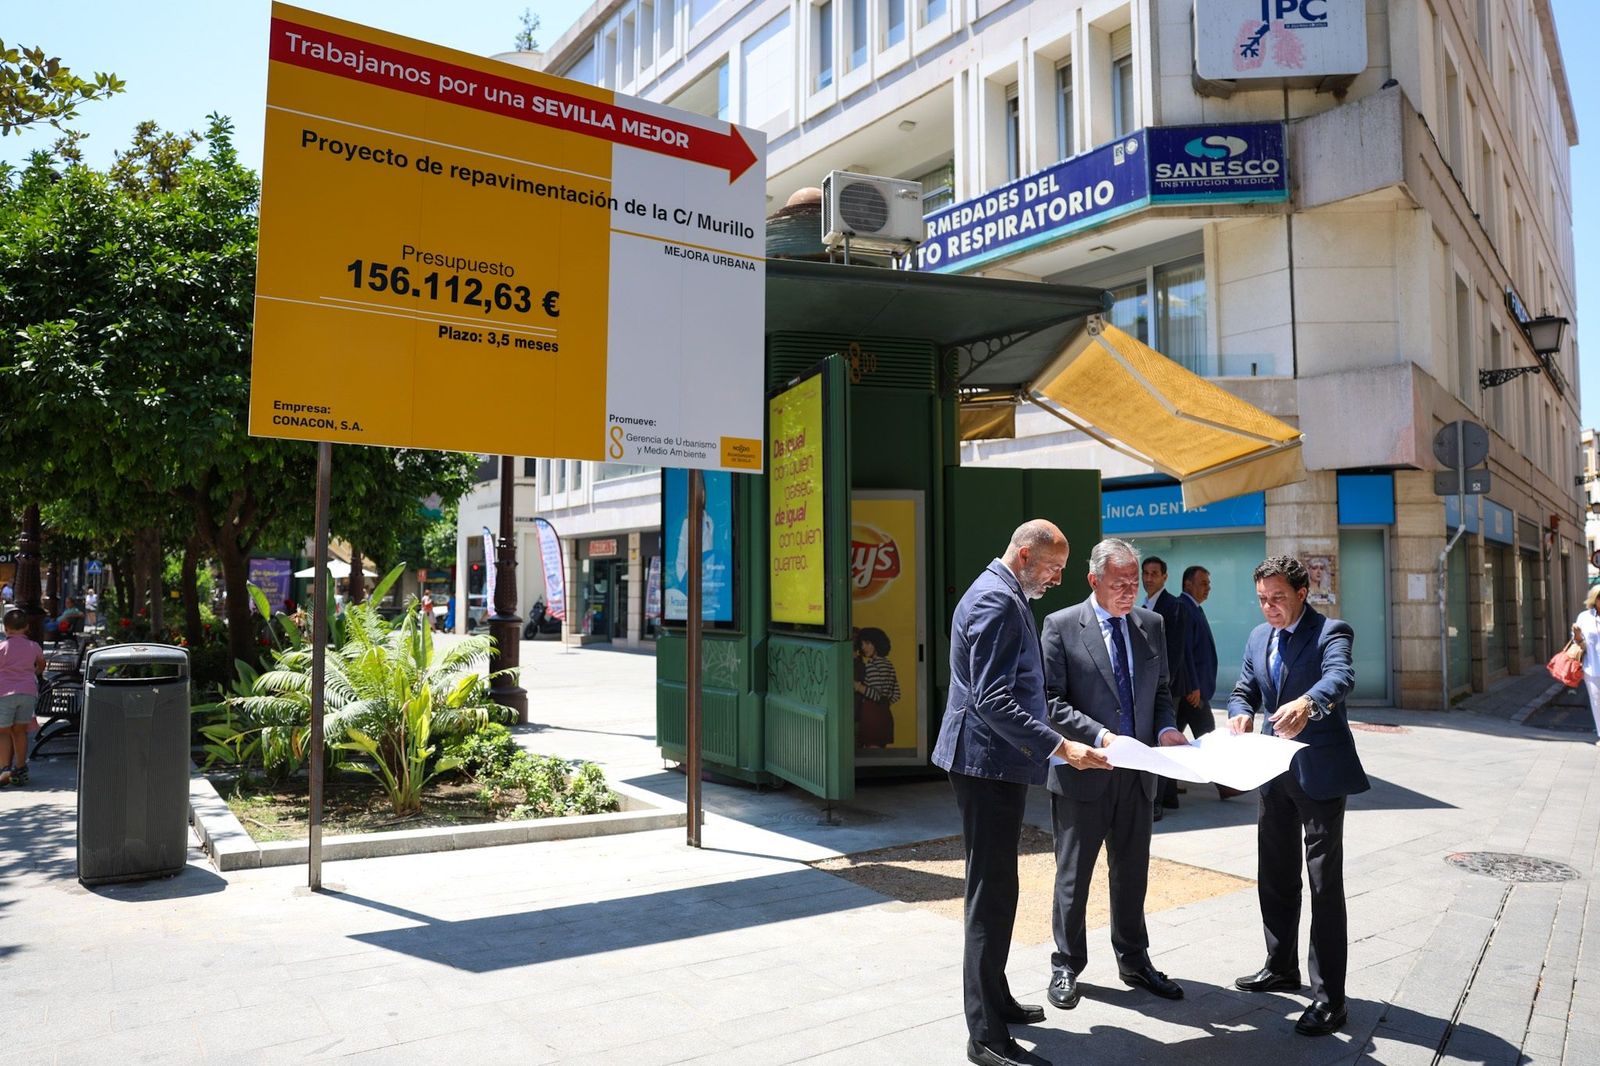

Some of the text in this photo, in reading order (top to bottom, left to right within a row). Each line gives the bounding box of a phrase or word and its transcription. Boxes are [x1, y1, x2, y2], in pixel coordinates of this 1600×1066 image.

[285, 31, 689, 148] Trabajamos por una SEVILLA MEJOR
[1155, 158, 1280, 178] SANESCO
[301, 129, 754, 239] Proyecto de repavimentación de la C/ Murillo
[1024, 174, 1060, 201] DEL
[948, 180, 1114, 258] RESPIRATORIO
[402, 245, 515, 278] Presupuesto
[664, 245, 756, 272] MEJORA URBANA
[347, 259, 560, 318] 156.112,63 €
[438, 325, 559, 353] Plazo: 3,5 meses
[273, 400, 331, 414] Empresa:
[608, 414, 656, 427] Promueve:
[272, 415, 364, 432] CONACON, S.A.
[626, 432, 716, 449] Gerencia de Urbanismo
[636, 446, 706, 458] y Medio Ambiente
